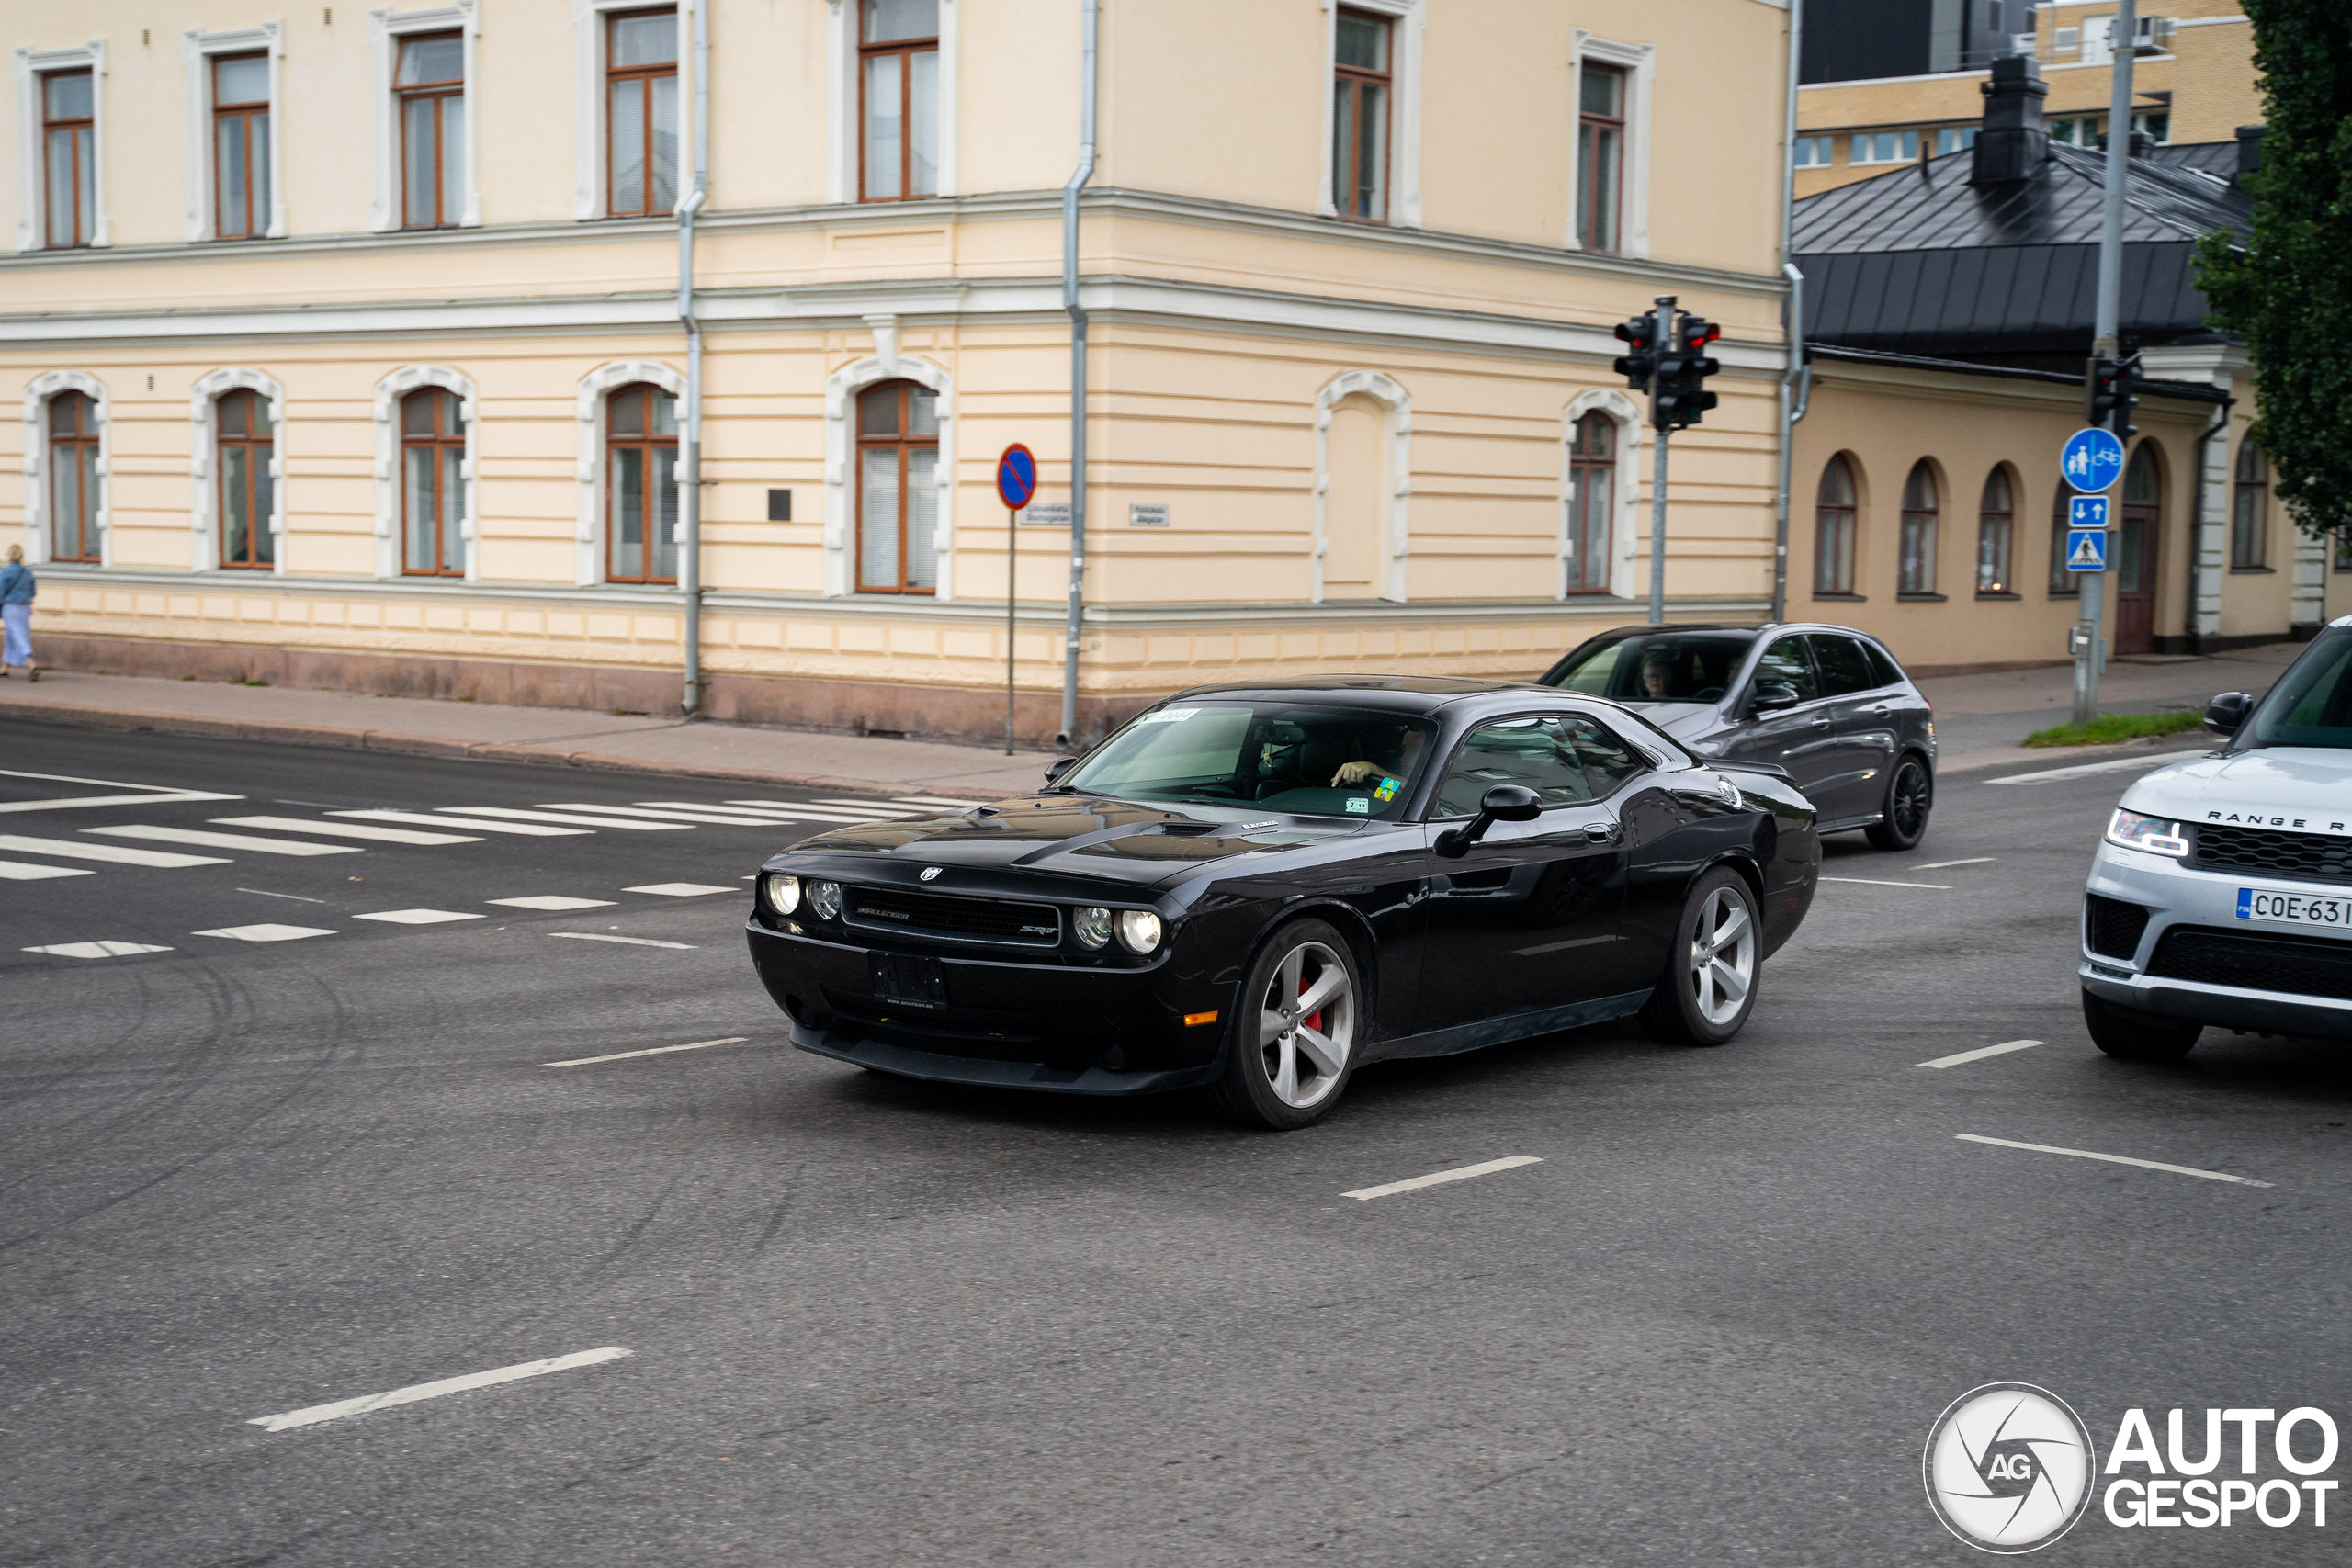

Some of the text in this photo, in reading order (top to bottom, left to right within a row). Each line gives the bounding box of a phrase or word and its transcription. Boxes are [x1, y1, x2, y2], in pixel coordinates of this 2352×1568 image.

[2207, 811, 2307, 828] RANGE
[857, 907, 910, 919] CHALLENGER
[2238, 905, 2251, 913] FIN
